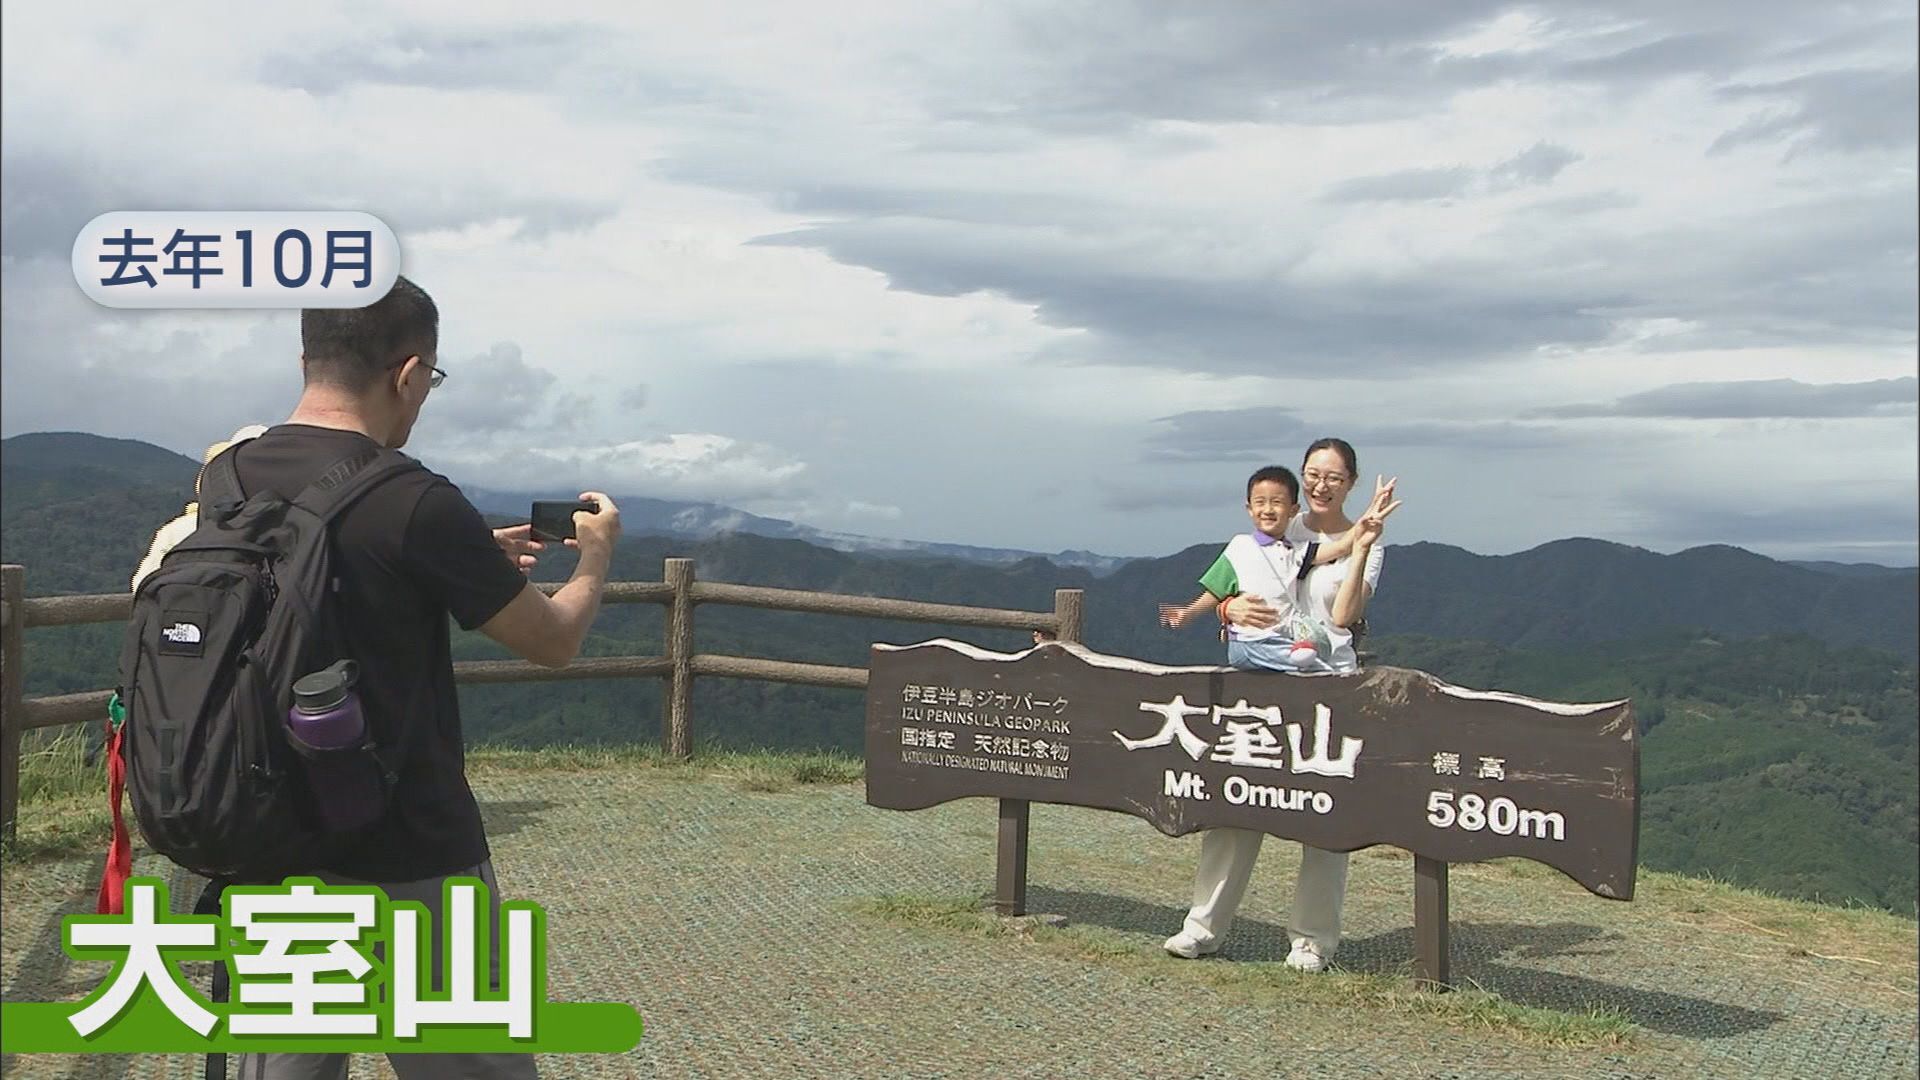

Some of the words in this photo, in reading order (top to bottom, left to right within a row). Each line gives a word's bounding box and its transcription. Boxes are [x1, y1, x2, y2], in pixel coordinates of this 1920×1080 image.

[902, 683, 1069, 714] 伊豆半島ジオパーク
[902, 707, 924, 721] IZU
[927, 708, 1001, 729] PENINSULA
[1004, 715, 1070, 734] GEOPARK
[1111, 694, 1364, 779] 大室山
[901, 727, 956, 750] 国指定
[973, 733, 1070, 761] 天然記念物
[901, 752, 945, 767] NATIONALLY
[945, 754, 989, 772] DESIGNATED
[990, 757, 1023, 776] NATURAL
[1163, 769, 1211, 800] Mt.
[1223, 776, 1334, 814] Omuro
[1426, 790, 1566, 841] 580m
